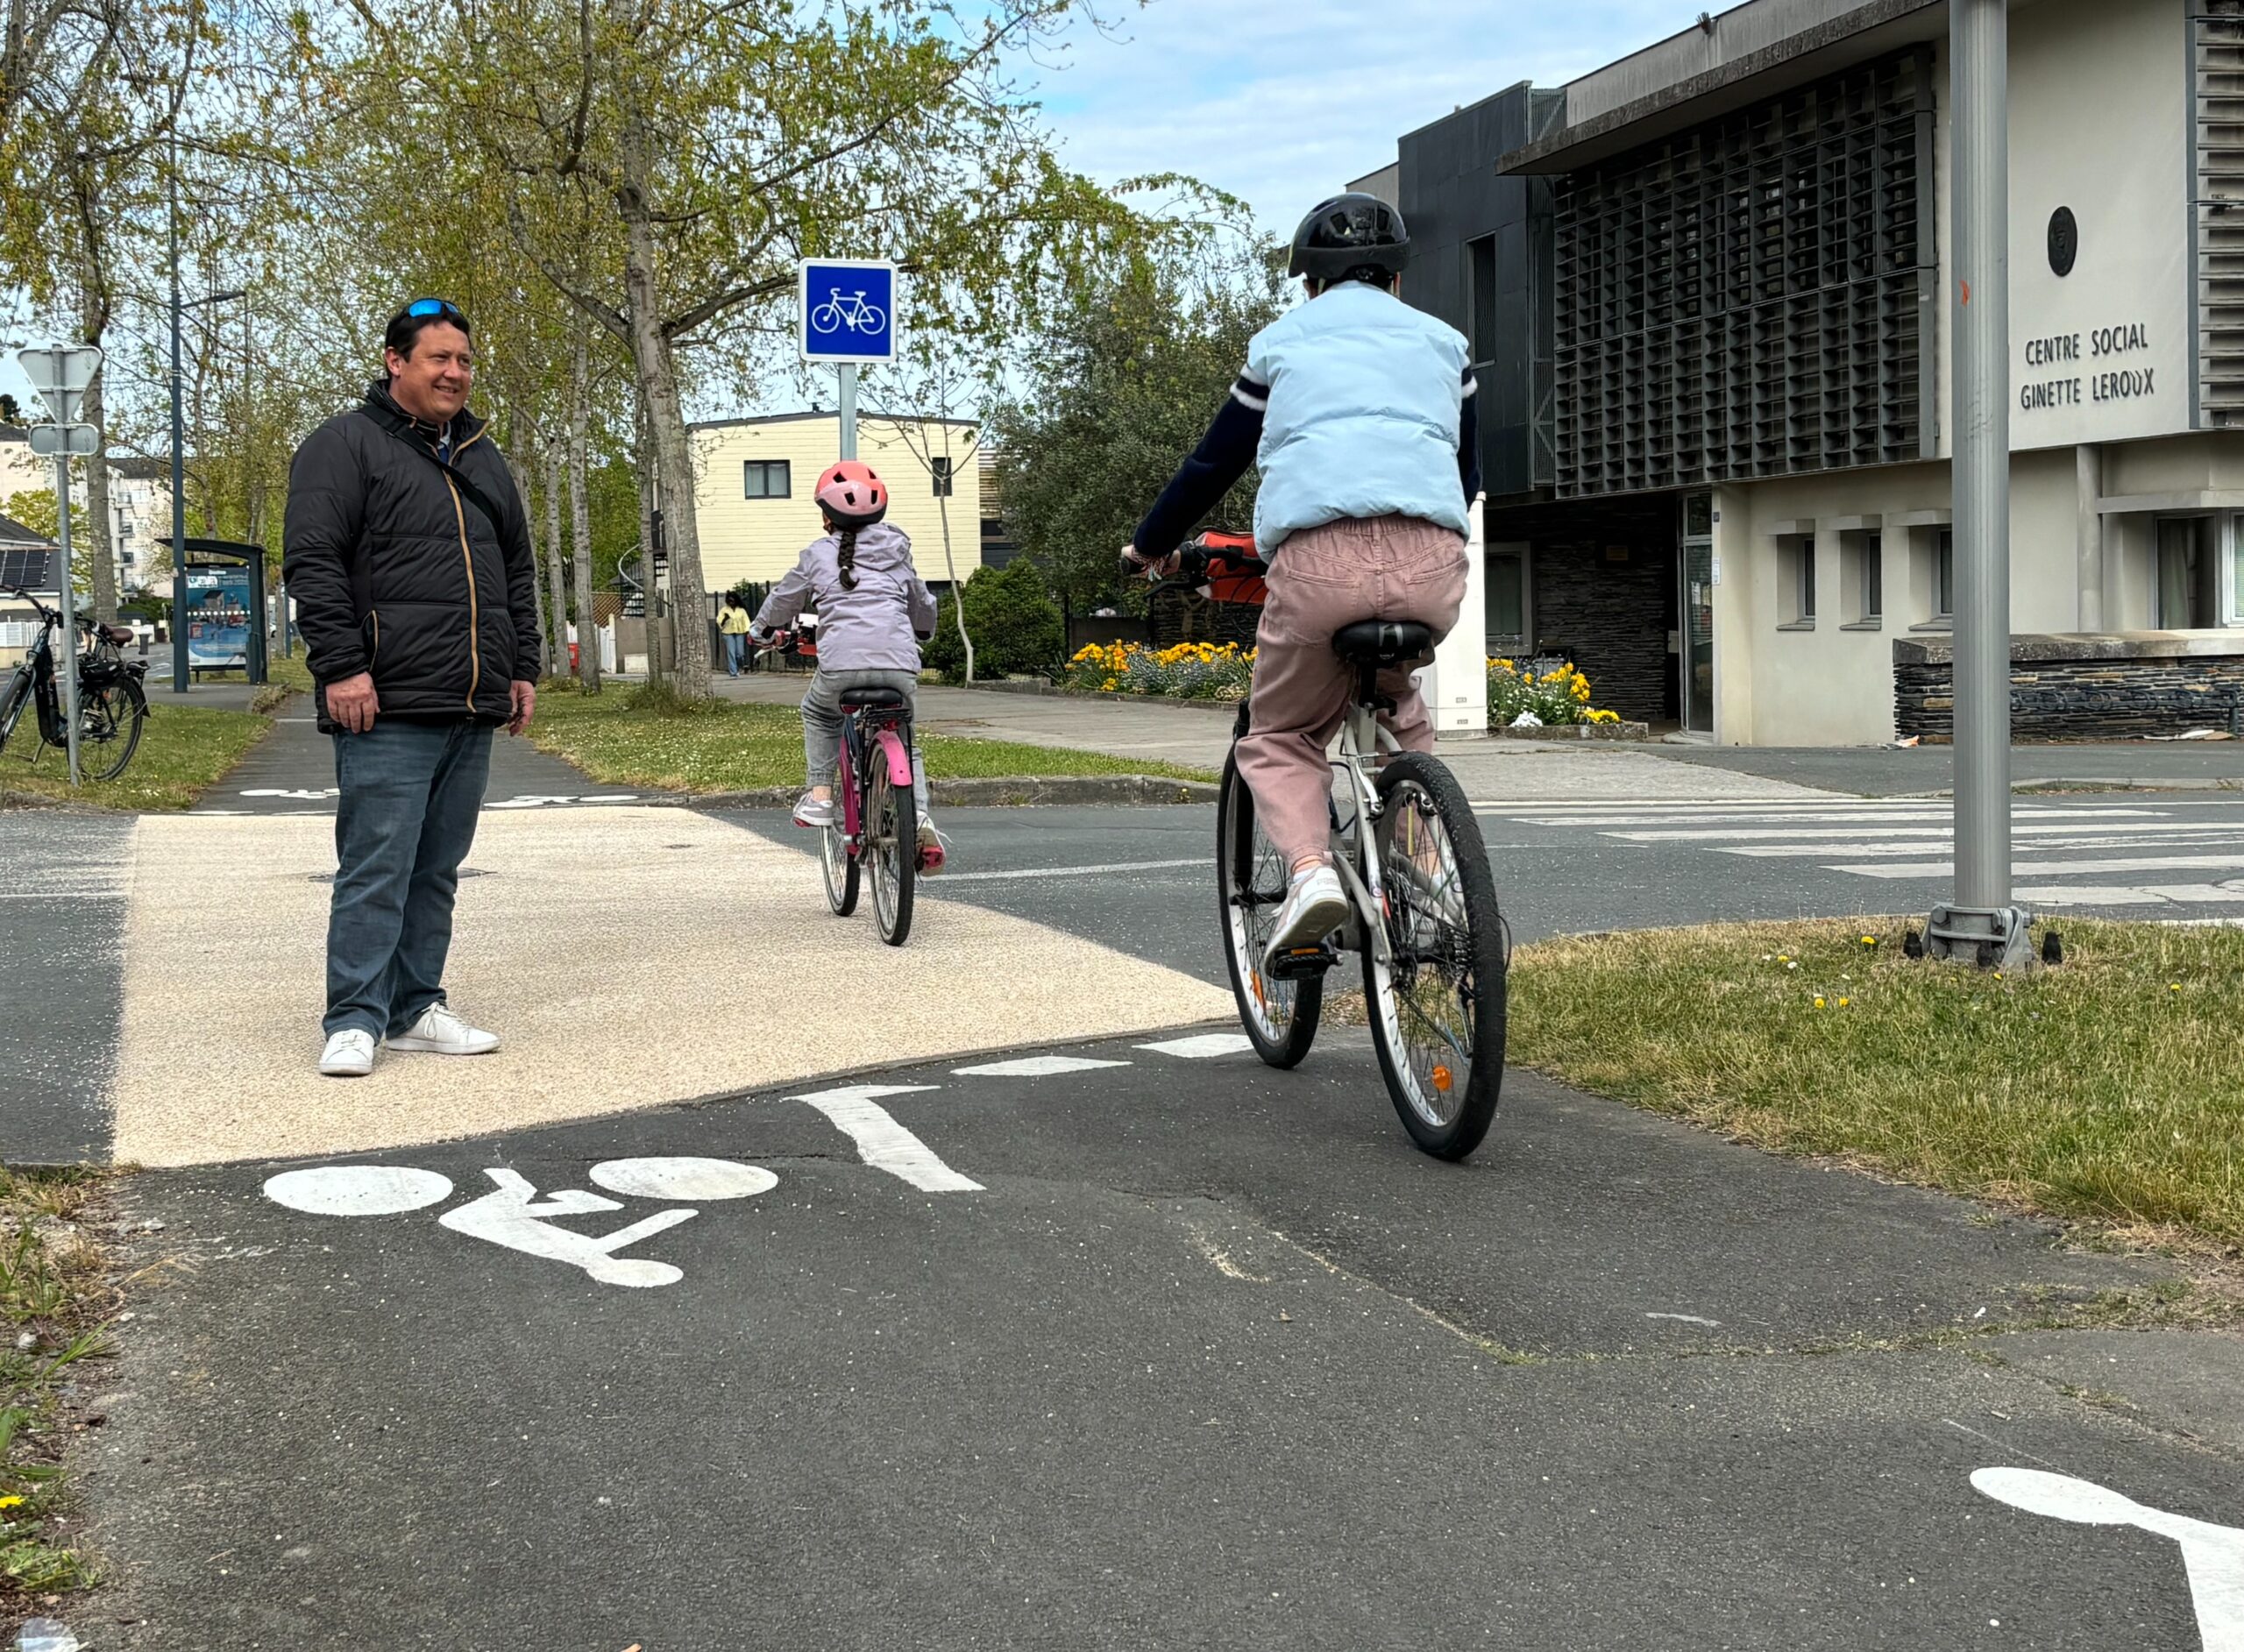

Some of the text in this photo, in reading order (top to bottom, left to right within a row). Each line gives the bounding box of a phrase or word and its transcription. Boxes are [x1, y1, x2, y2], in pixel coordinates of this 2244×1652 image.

[2025, 323, 2148, 365] CENTRE SOCIAL
[2020, 367, 2155, 409] GINETTE LEROUX
